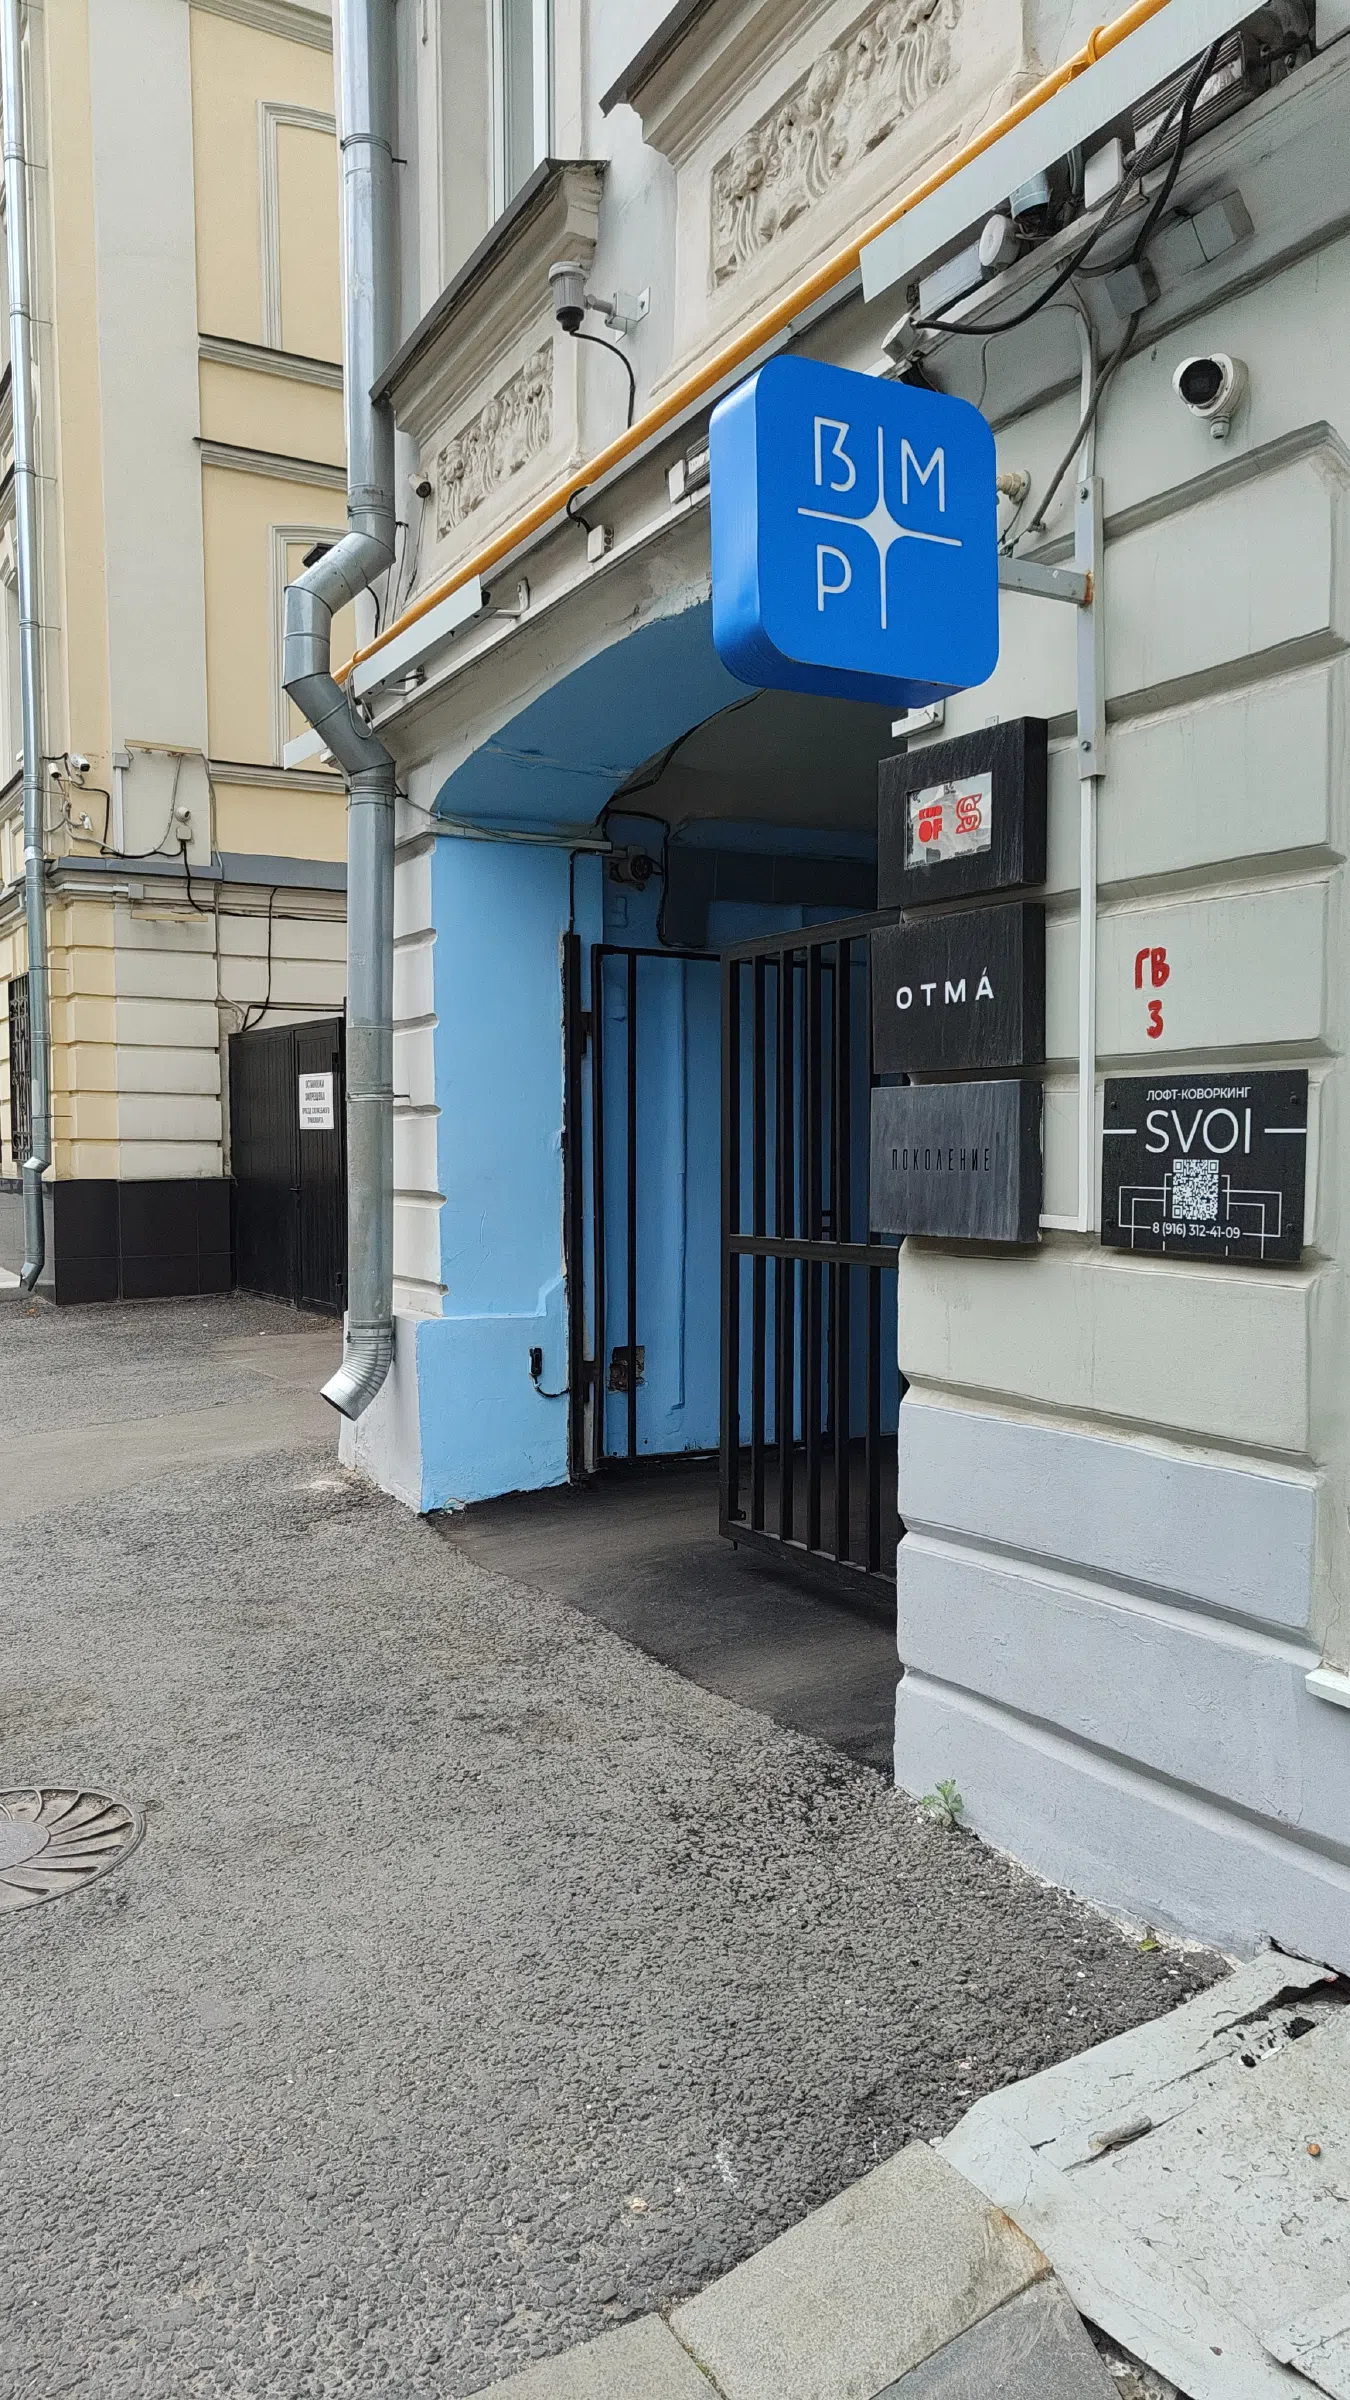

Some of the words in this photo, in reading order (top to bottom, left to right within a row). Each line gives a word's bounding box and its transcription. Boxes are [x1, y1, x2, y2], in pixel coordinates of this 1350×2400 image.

[918, 818, 943, 843] OF
[1134, 946, 1171, 990] ГВ
[1146, 1086, 1252, 1101] ЛОФТ-КОВОРКИНГ
[1145, 1107, 1252, 1154] SVOI
[891, 1148, 990, 1172] ПОКОЛЕНИЕ
[1152, 1222, 1160, 1234] 8
[1162, 1222, 1187, 1237] (916)
[1188, 1224, 1241, 1239] 312-41-09
